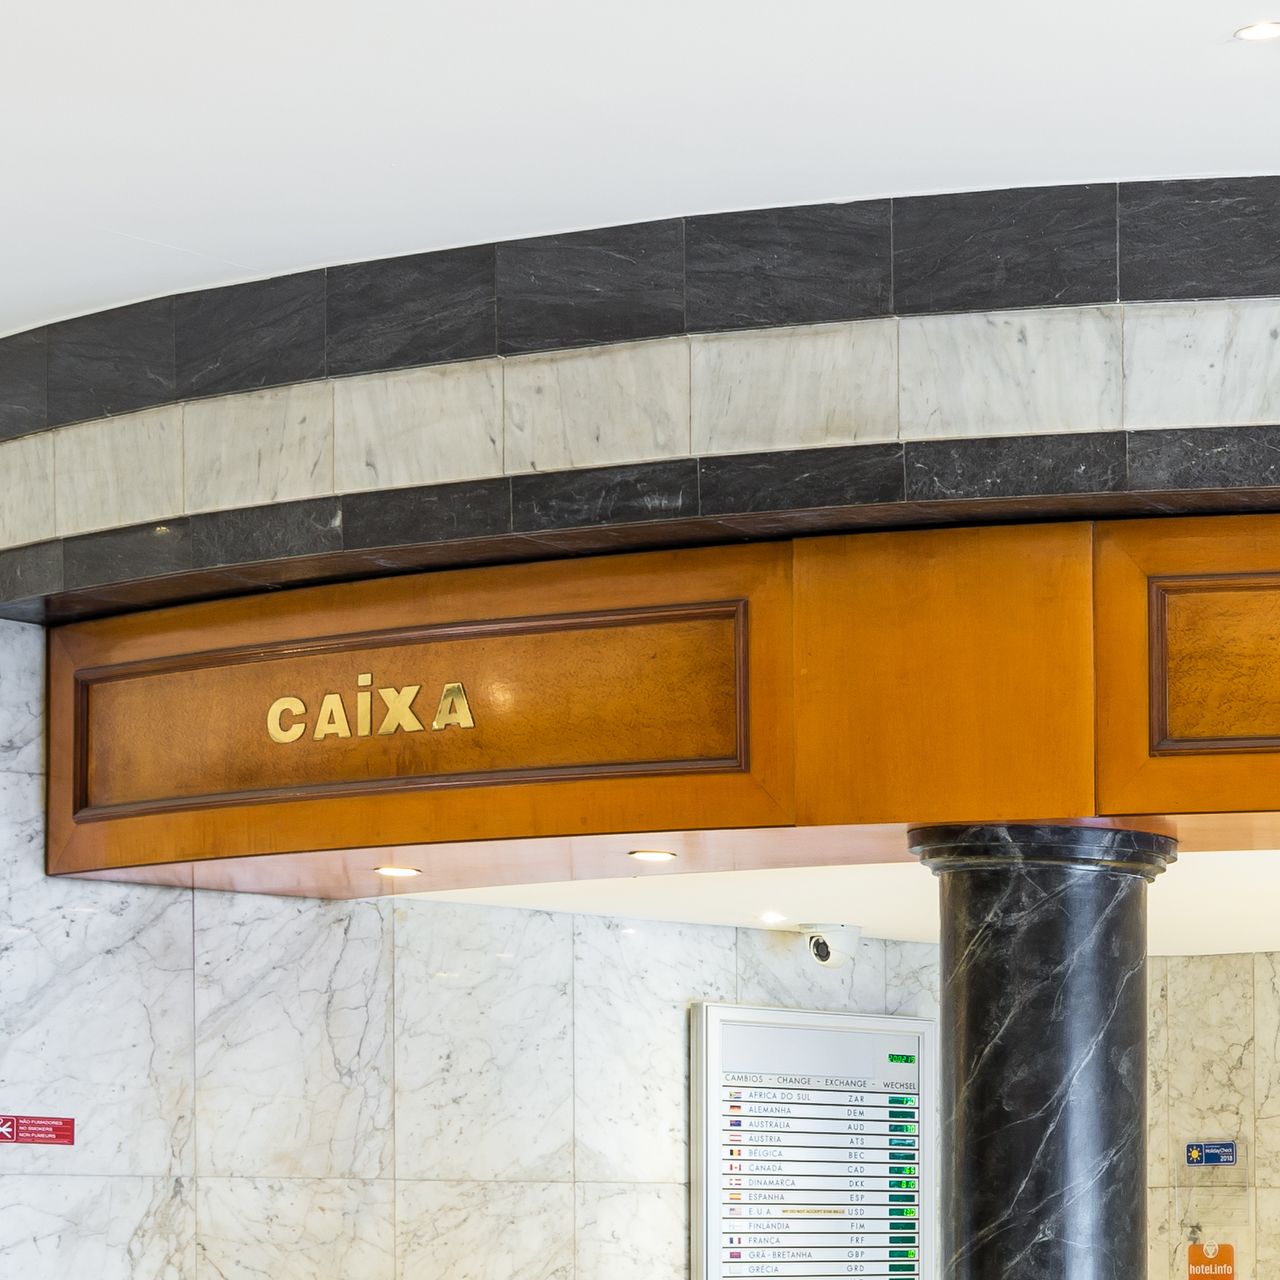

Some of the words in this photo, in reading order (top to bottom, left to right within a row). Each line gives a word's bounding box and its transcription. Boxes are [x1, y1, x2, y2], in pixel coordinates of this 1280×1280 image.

[777, 1076, 811, 1086] CHANGE
[825, 1079, 867, 1088] EXCHANGE
[883, 1081, 916, 1090] WECHSEL
[780, 1092, 794, 1101] DO
[796, 1093, 811, 1102] SUL
[848, 1095, 865, 1103] ZAR
[748, 1106, 792, 1114] ALEMANHA
[847, 1109, 865, 1117] DEM
[847, 1123, 865, 1131] AUD
[849, 1138, 865, 1146] ATS
[847, 1166, 865, 1174] CAD
[748, 1178, 796, 1187] DINAMARCA
[849, 1180, 865, 1188] DKK
[748, 1193, 785, 1201] ESPANHA
[849, 1194, 865, 1202] ESP
[847, 1208, 865, 1216] USD
[850, 1222, 865, 1230] FIM
[850, 1236, 865, 1244] FRF
[847, 1250, 865, 1258] GBP
[846, 1264, 865, 1272] GRD
[1189, 1263, 1233, 1275] hotel.info
